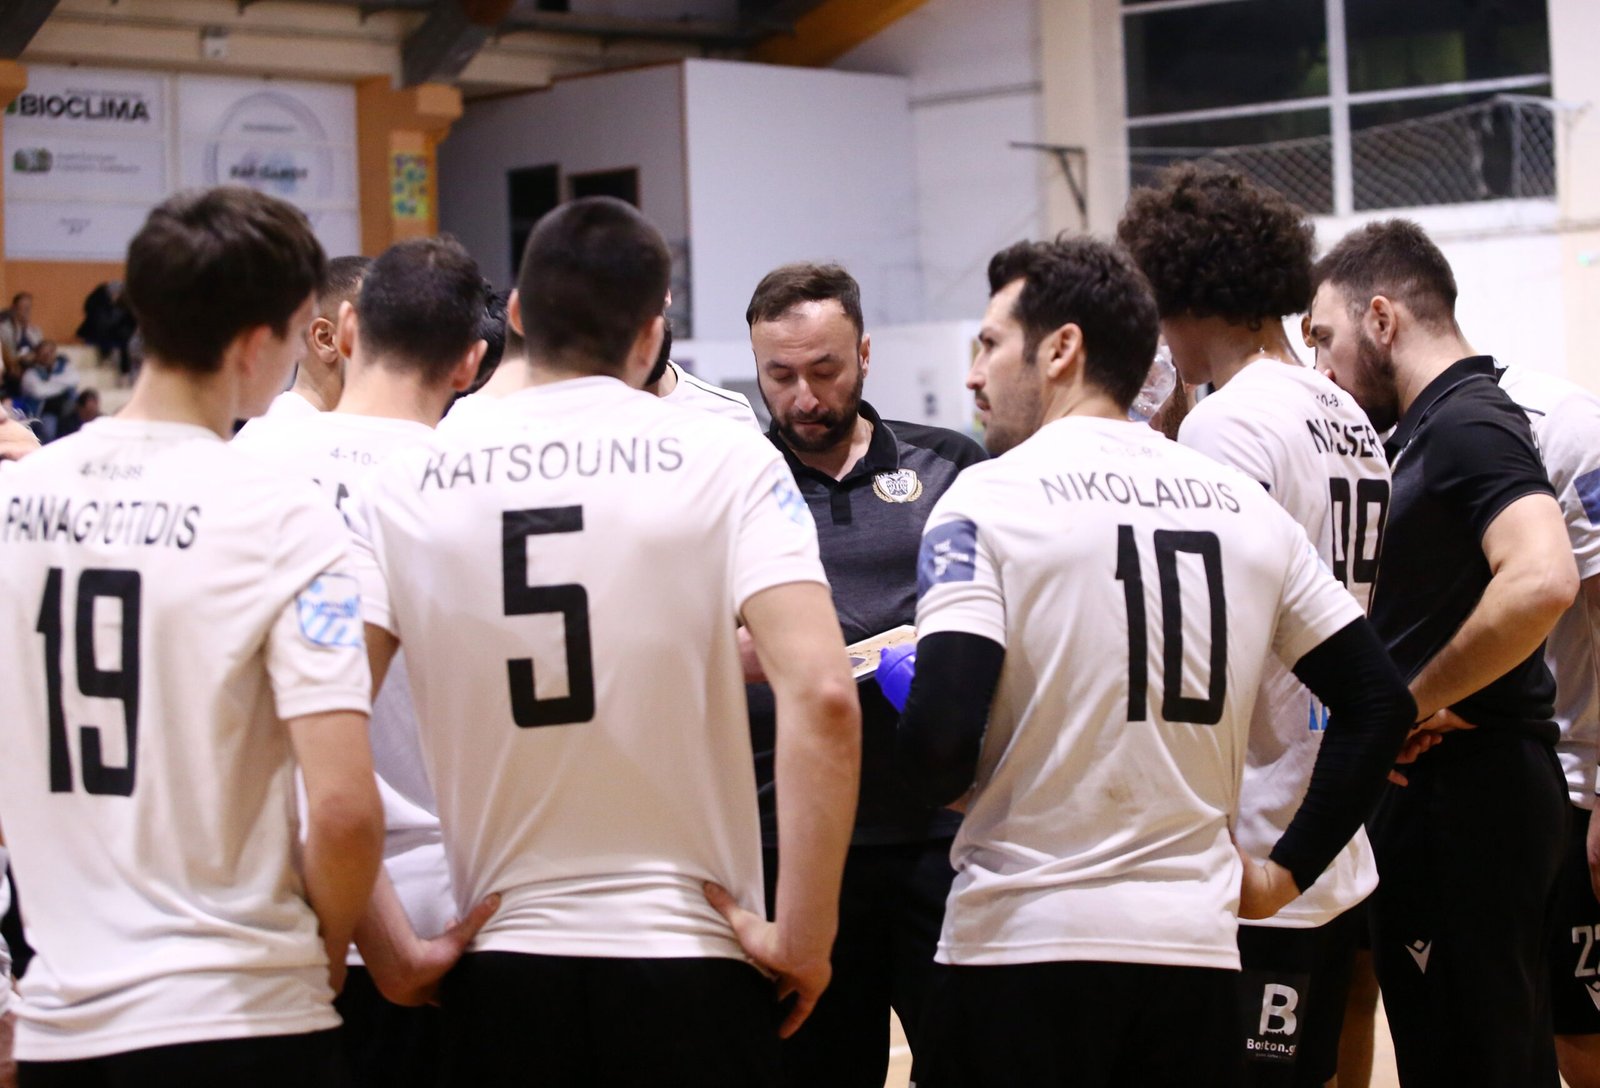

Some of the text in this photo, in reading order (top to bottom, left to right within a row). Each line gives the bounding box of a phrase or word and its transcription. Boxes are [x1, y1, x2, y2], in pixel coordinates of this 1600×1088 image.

[20, 95, 150, 121] BIOCLIMA
[420, 437, 684, 492] KATSOUNIS
[1040, 471, 1241, 514] NIKOLAIDIS
[3, 496, 201, 550] PANAGIOTIDIS
[1329, 477, 1390, 620] 99
[502, 505, 596, 728] 5
[1115, 524, 1229, 725] 10
[37, 567, 142, 797] 19
[1571, 923, 1600, 977] 2
[1259, 983, 1299, 1036] B
